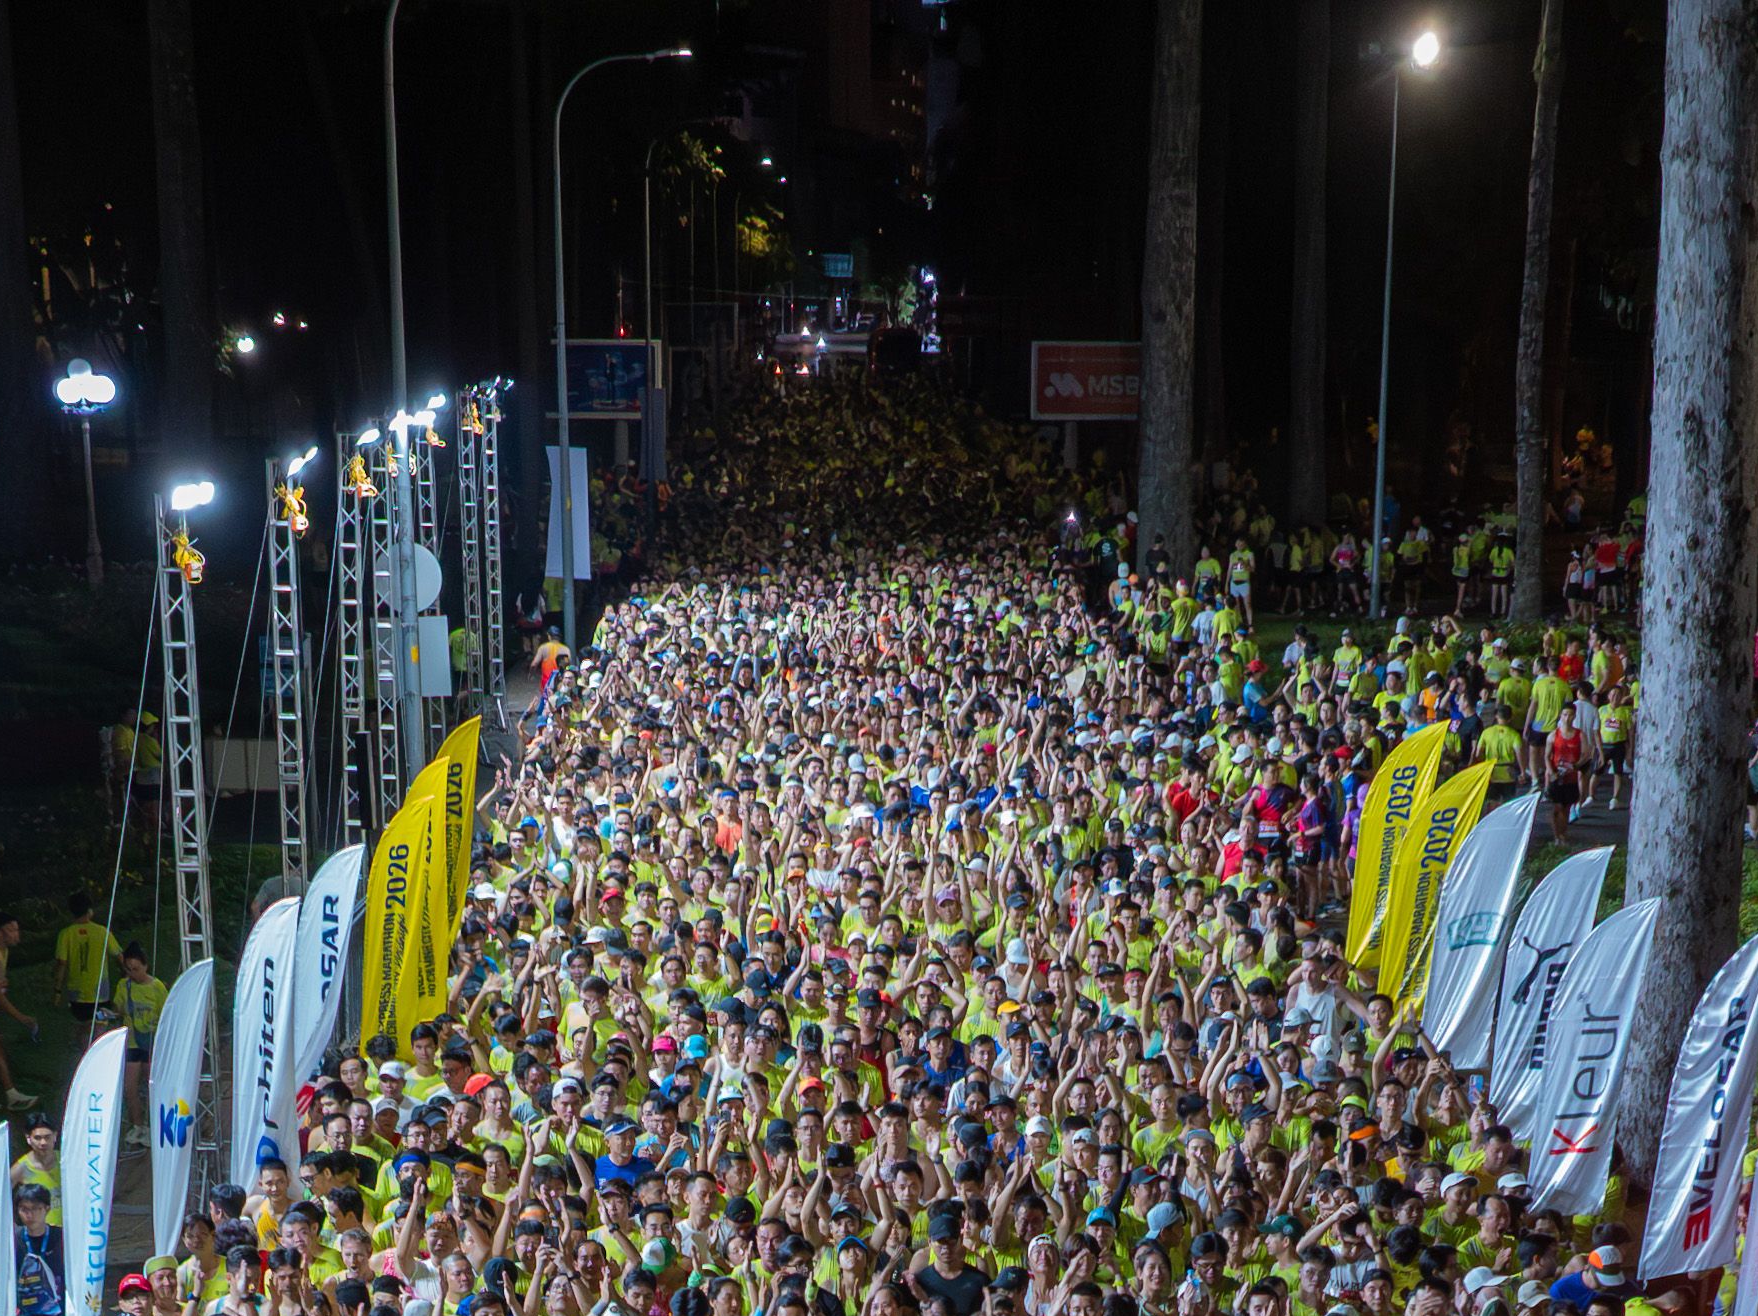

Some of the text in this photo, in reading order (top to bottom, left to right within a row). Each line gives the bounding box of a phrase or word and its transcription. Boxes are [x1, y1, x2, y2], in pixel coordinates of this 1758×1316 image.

[1086, 375, 1141, 397] MSB
[1376, 765, 1417, 888] MARATHON 2026
[1411, 807, 1459, 935] MARATHON 2026
[382, 844, 409, 981] MARATHON 2026
